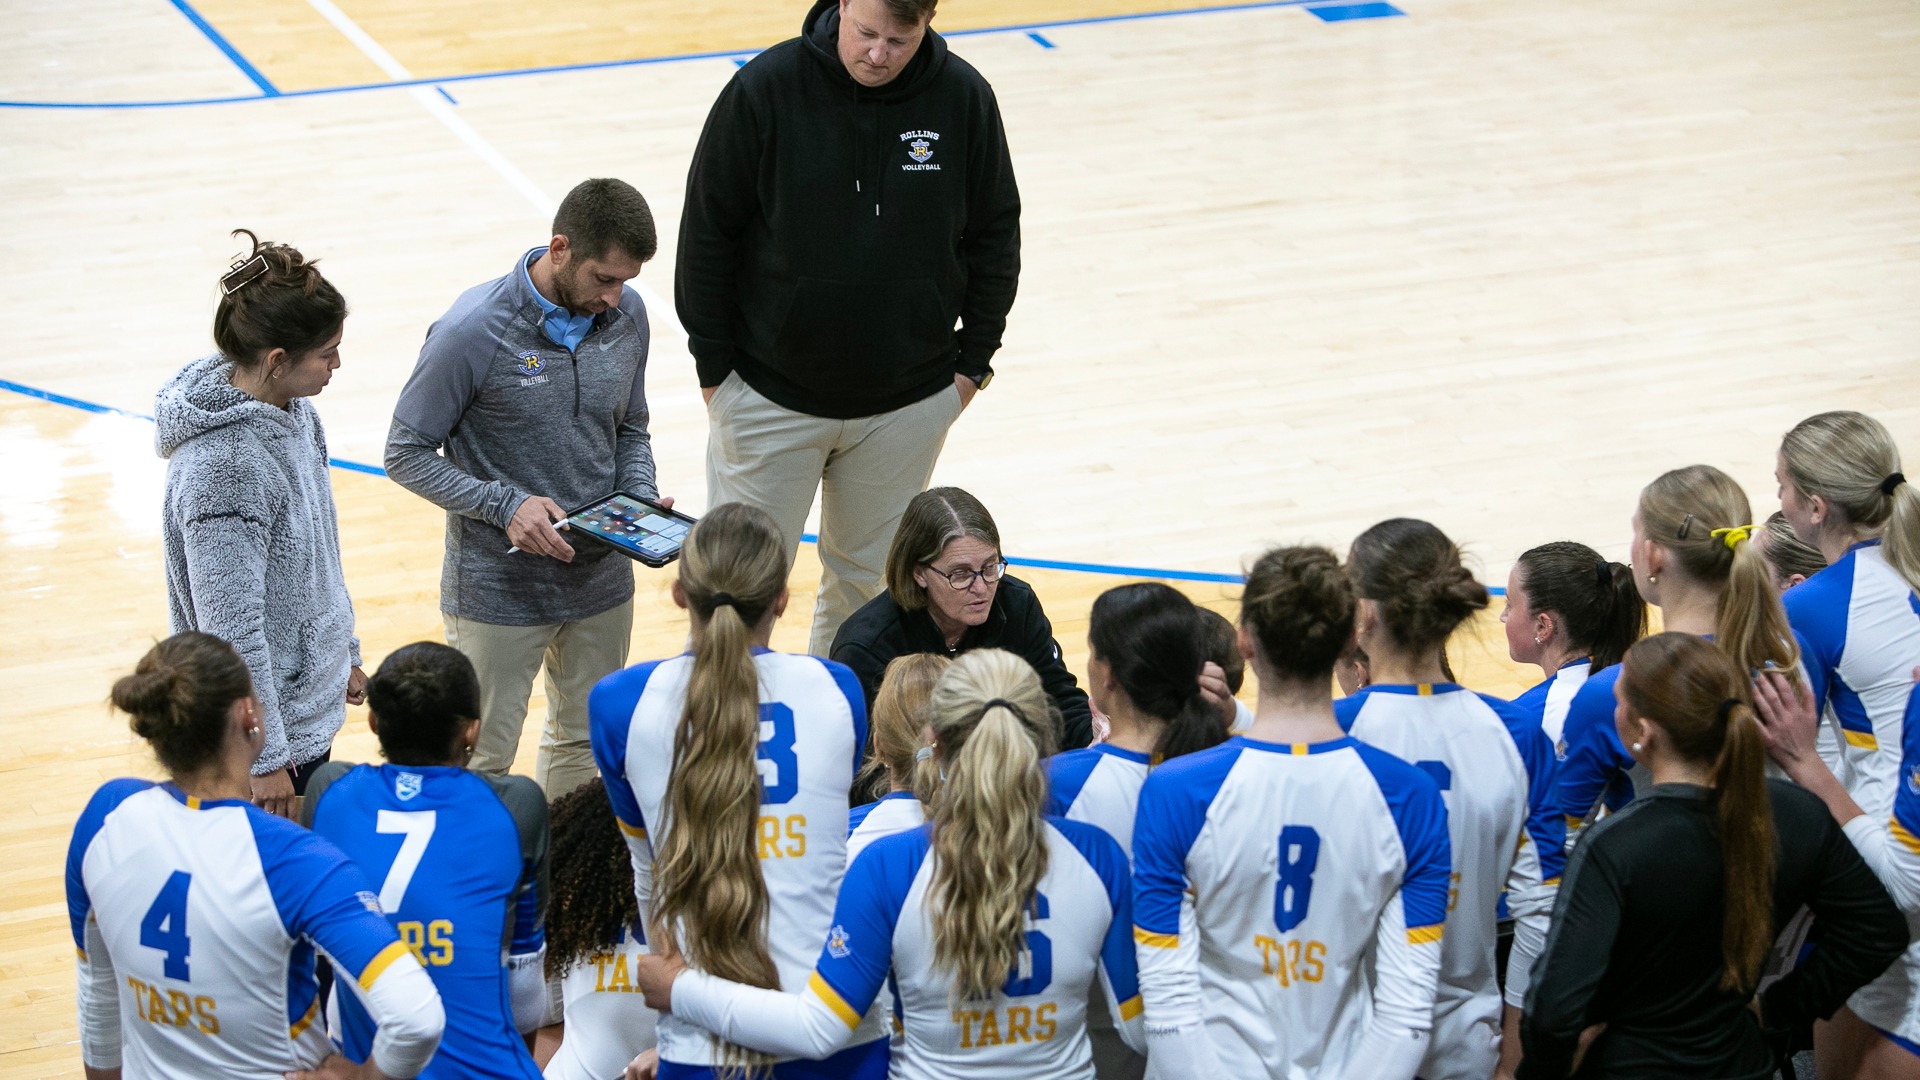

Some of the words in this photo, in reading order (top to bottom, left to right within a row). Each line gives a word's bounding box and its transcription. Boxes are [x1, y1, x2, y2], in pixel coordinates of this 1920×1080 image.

[900, 130, 940, 141] ROLLINS
[756, 702, 798, 805] 3
[376, 809, 437, 914] 7
[756, 814, 806, 859] RS
[1274, 825, 1320, 933] 8
[140, 869, 192, 982] 4
[397, 919, 454, 966] RS
[1000, 888, 1052, 998] 6
[592, 952, 642, 993] TA
[127, 975, 220, 1035] TARS
[952, 1002, 1057, 1048] TARS
